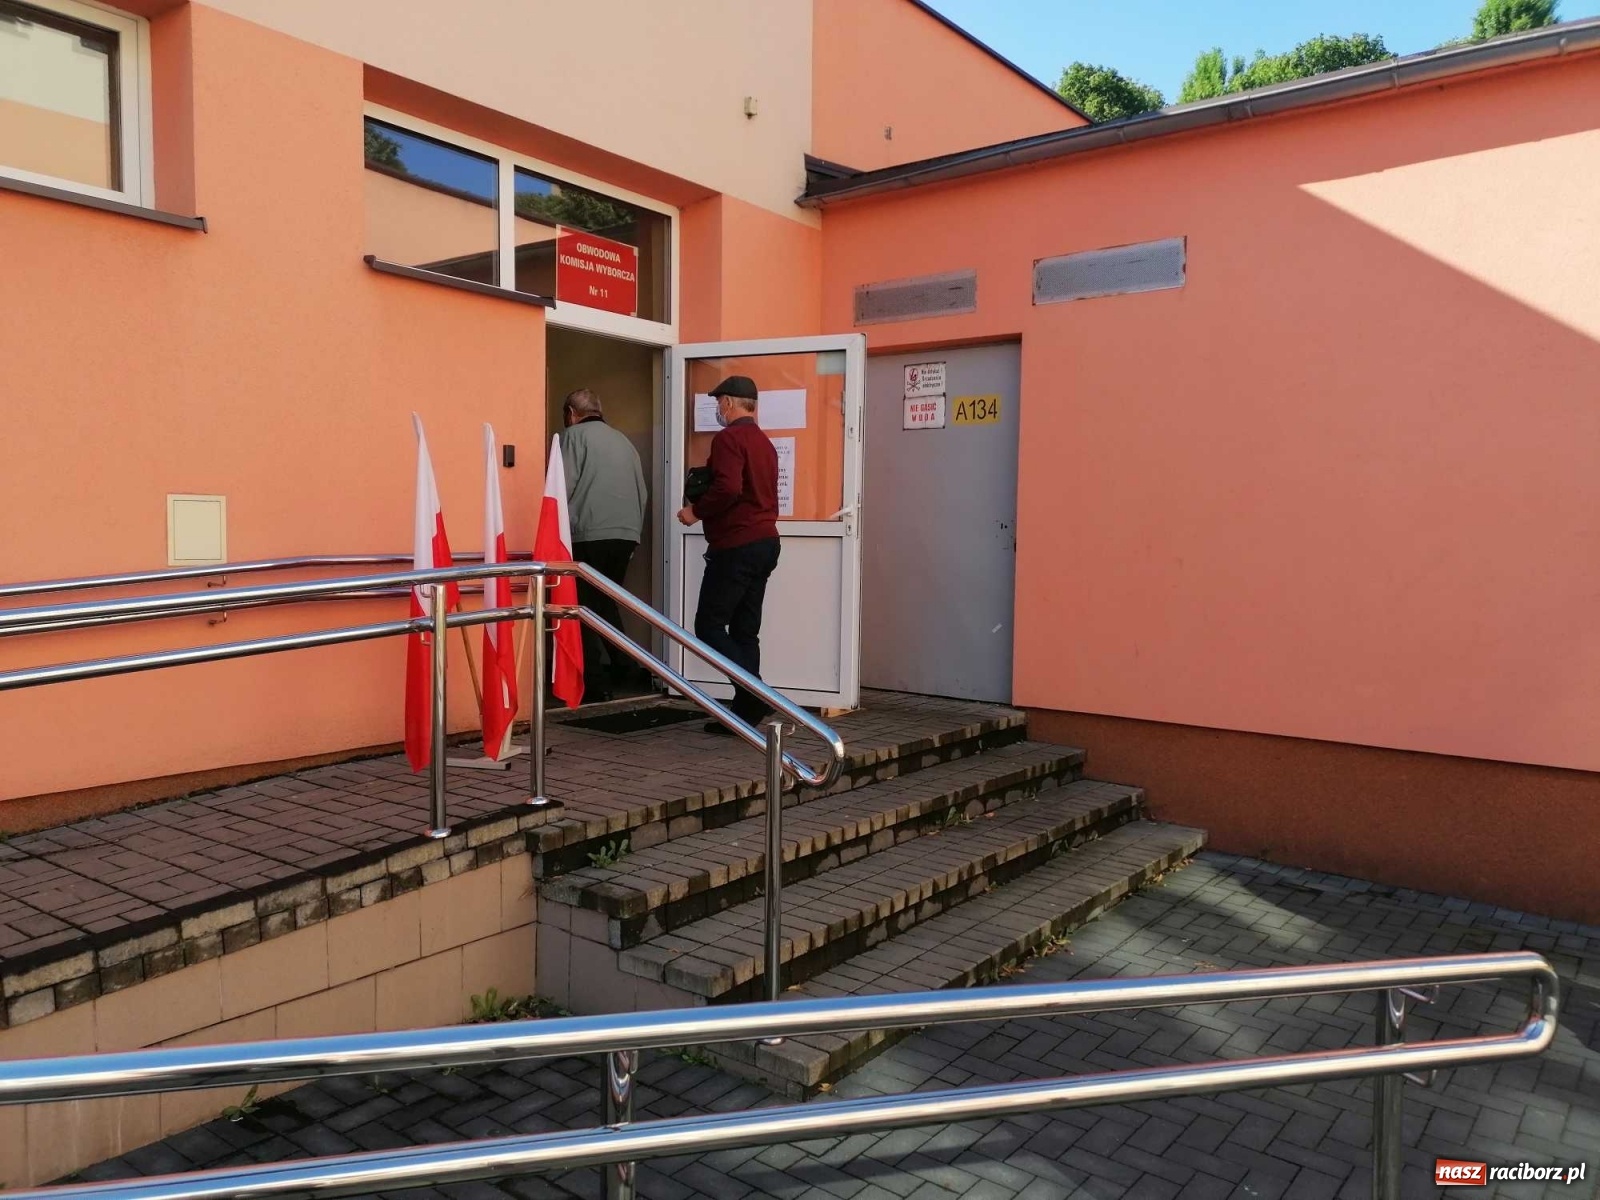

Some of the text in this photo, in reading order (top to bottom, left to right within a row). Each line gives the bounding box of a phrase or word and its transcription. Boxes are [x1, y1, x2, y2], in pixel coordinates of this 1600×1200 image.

[576, 242, 621, 263] OBWODOWA
[560, 254, 635, 282] KOMISJA WYBORCZA
[589, 285, 608, 298] Nr 11
[910, 404, 919, 412] NIE
[956, 398, 998, 421] A134
